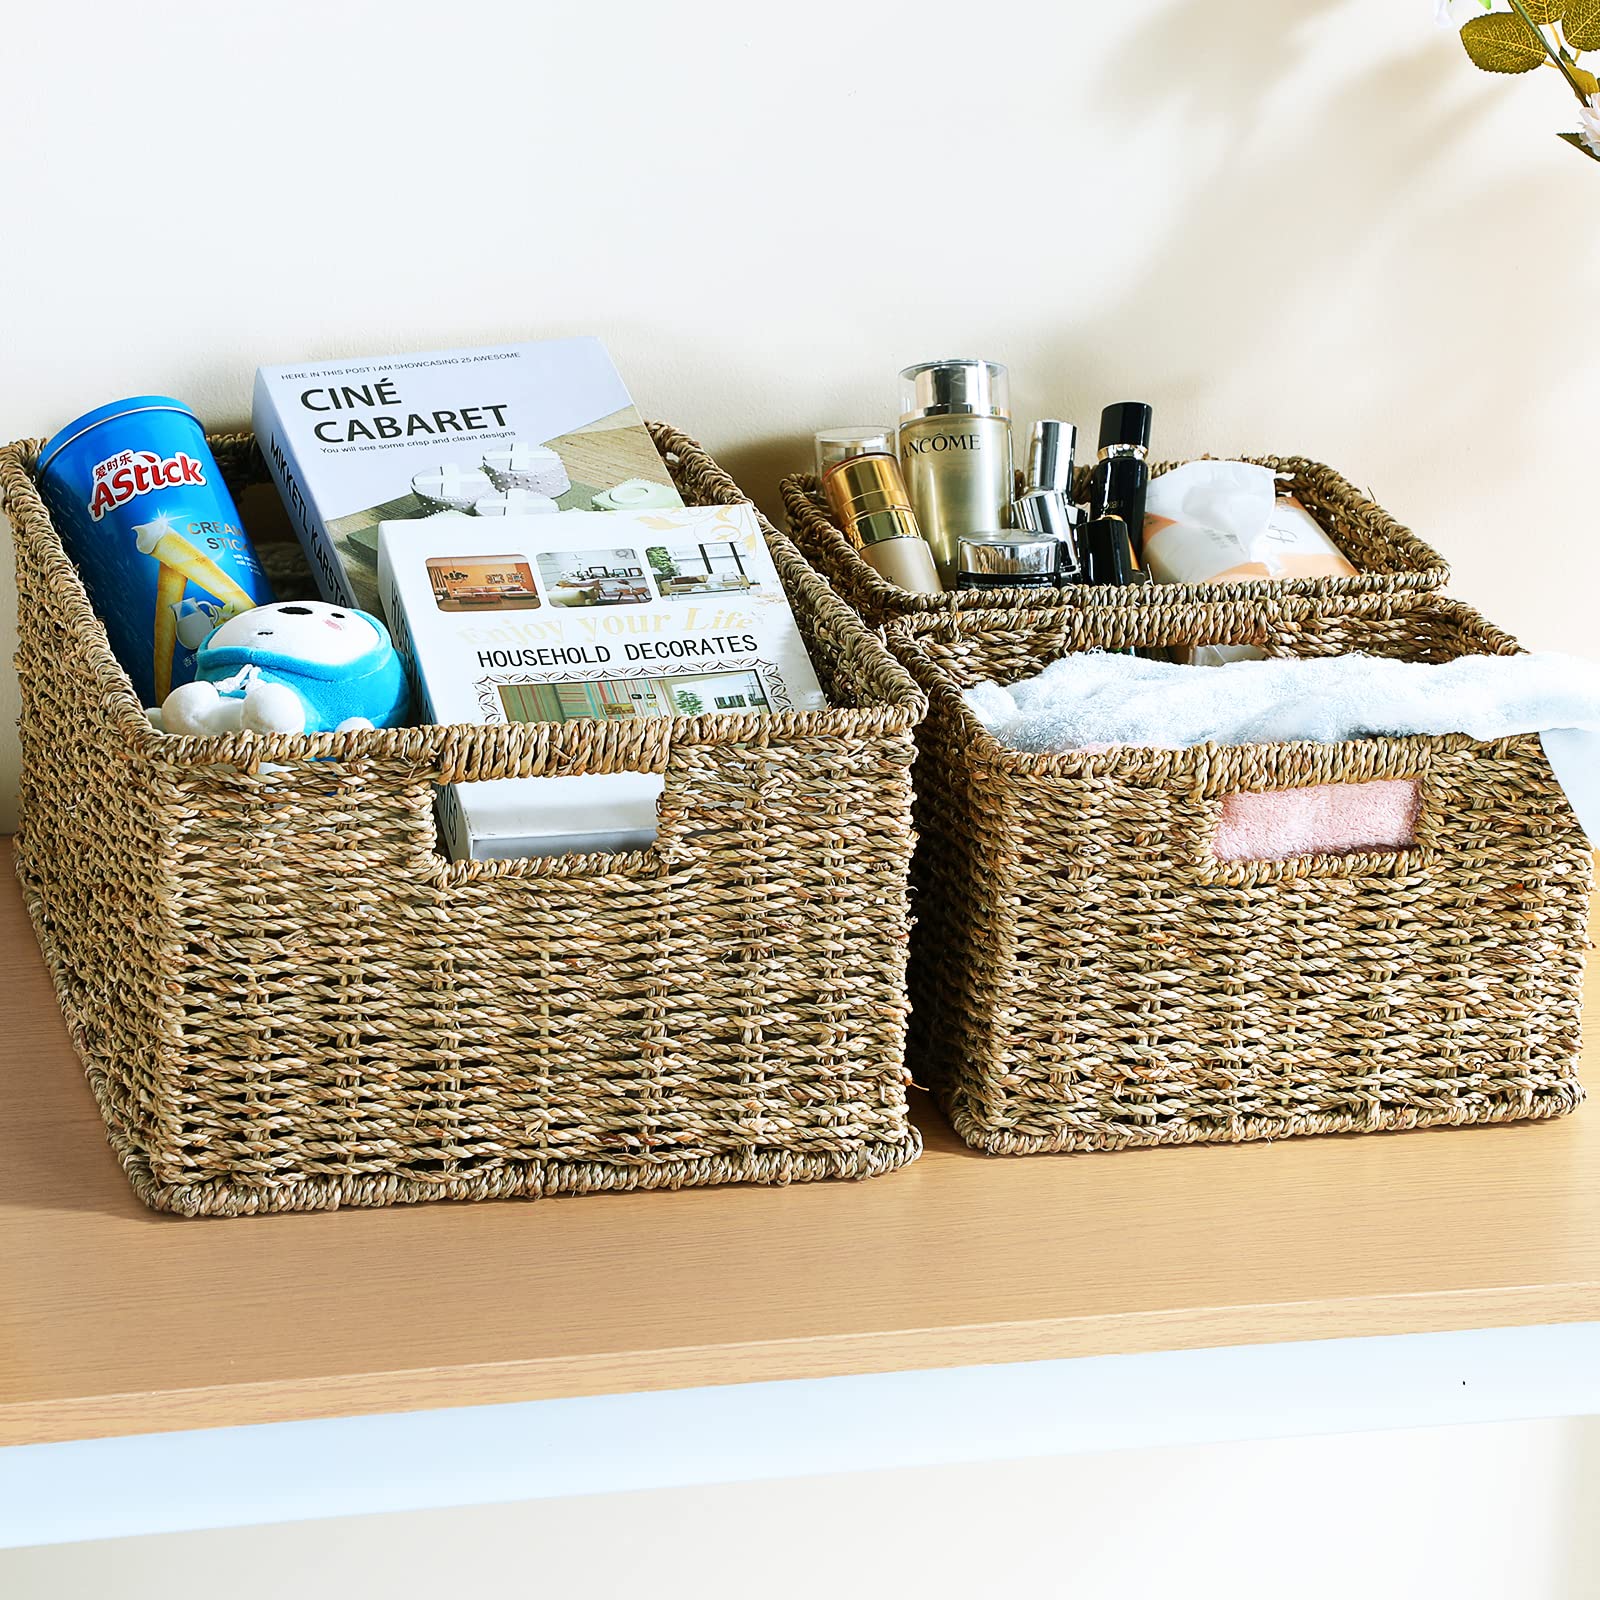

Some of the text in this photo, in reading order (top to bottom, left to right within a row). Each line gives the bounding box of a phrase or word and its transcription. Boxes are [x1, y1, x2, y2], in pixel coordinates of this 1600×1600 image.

[345, 367, 370, 375] POST
[394, 358, 459, 370] SHOWCASING
[473, 351, 521, 362] AWESOME
[300, 378, 402, 412] CINÉ
[313, 404, 509, 443] CABARET
[407, 438, 430, 447] crisp
[479, 431, 516, 440] designs
[95, 452, 133, 481] 爱时乐
[206, 537, 248, 551] STIC
[577, 612, 671, 643] your
[683, 607, 754, 631] Life
[477, 634, 758, 668] HOUSEHOLD DECORATES
